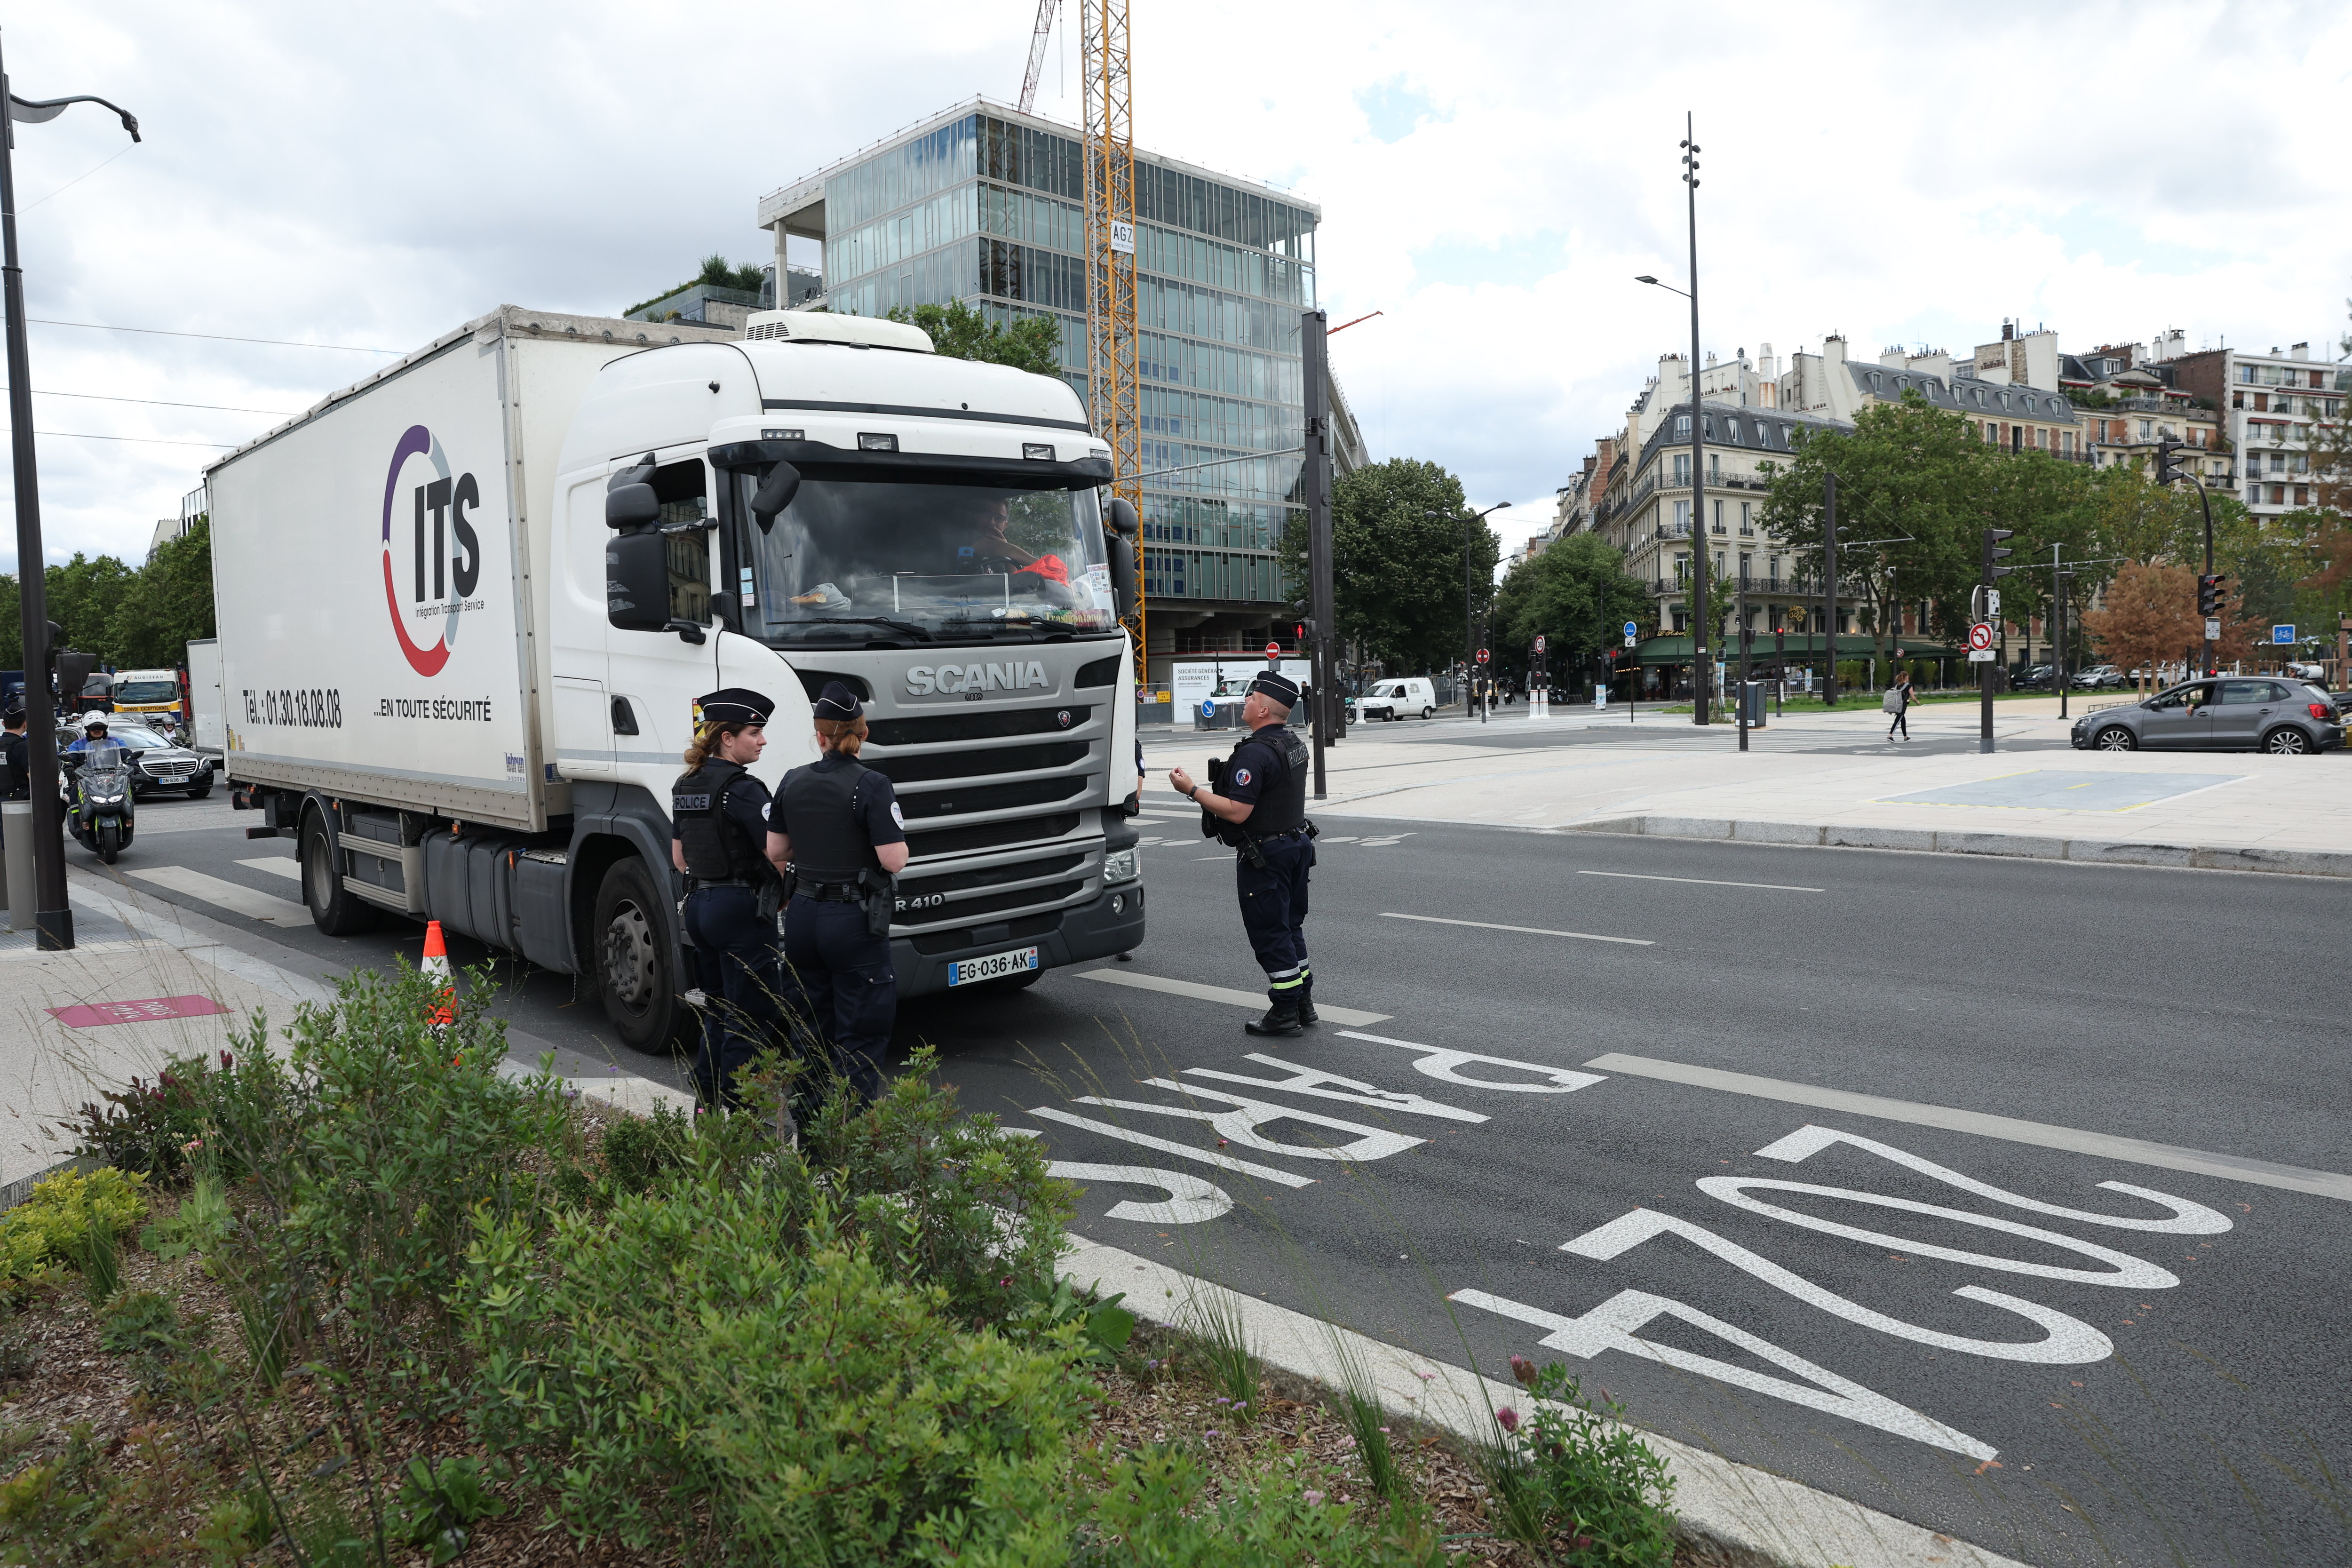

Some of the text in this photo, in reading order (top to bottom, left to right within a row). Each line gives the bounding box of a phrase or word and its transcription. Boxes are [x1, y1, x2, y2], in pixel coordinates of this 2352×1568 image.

[1113, 225, 1133, 243] AGZ
[415, 472, 480, 603] ITS
[415, 599, 485, 619] Intégration Transport Service
[906, 661, 1049, 696] SCANIA
[243, 689, 260, 724] Tél.
[266, 688, 342, 729] 01.30.18.08.08
[396, 699, 430, 719] TOUTE
[432, 695, 492, 722] SÉCURITÉ
[1288, 744, 1308, 765] POLICE
[675, 796, 706, 809] POLICE
[895, 895, 942, 912] R 410
[958, 952, 1028, 981] EG-036-AK
[1447, 1124, 2233, 1461] 2024
